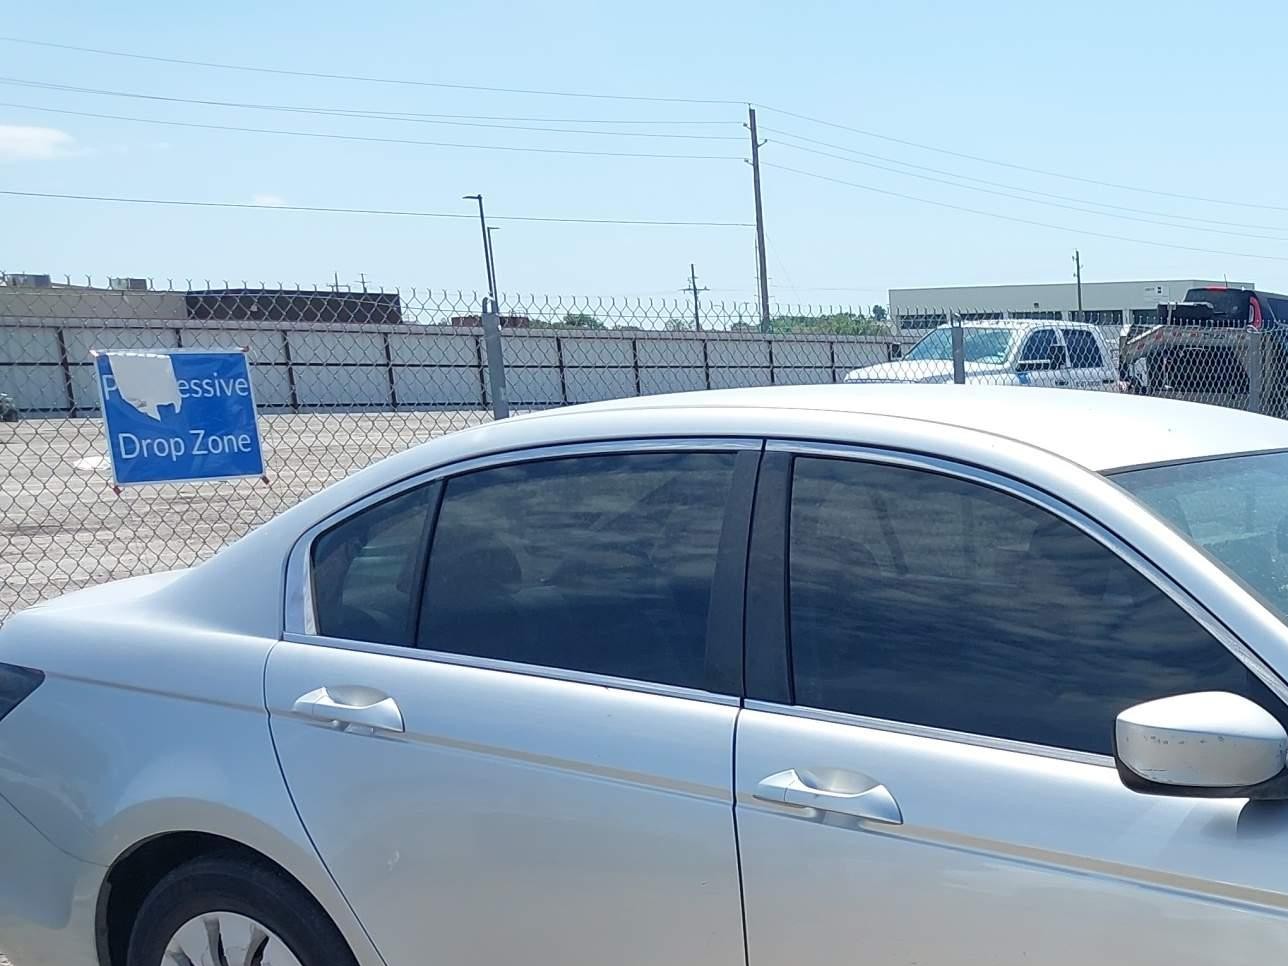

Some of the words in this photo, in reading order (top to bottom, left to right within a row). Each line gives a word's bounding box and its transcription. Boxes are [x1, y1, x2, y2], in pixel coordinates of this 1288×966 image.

[101, 372, 249, 401] Pessive
[118, 432, 185, 462] Drop
[188, 429, 252, 455] Zone
